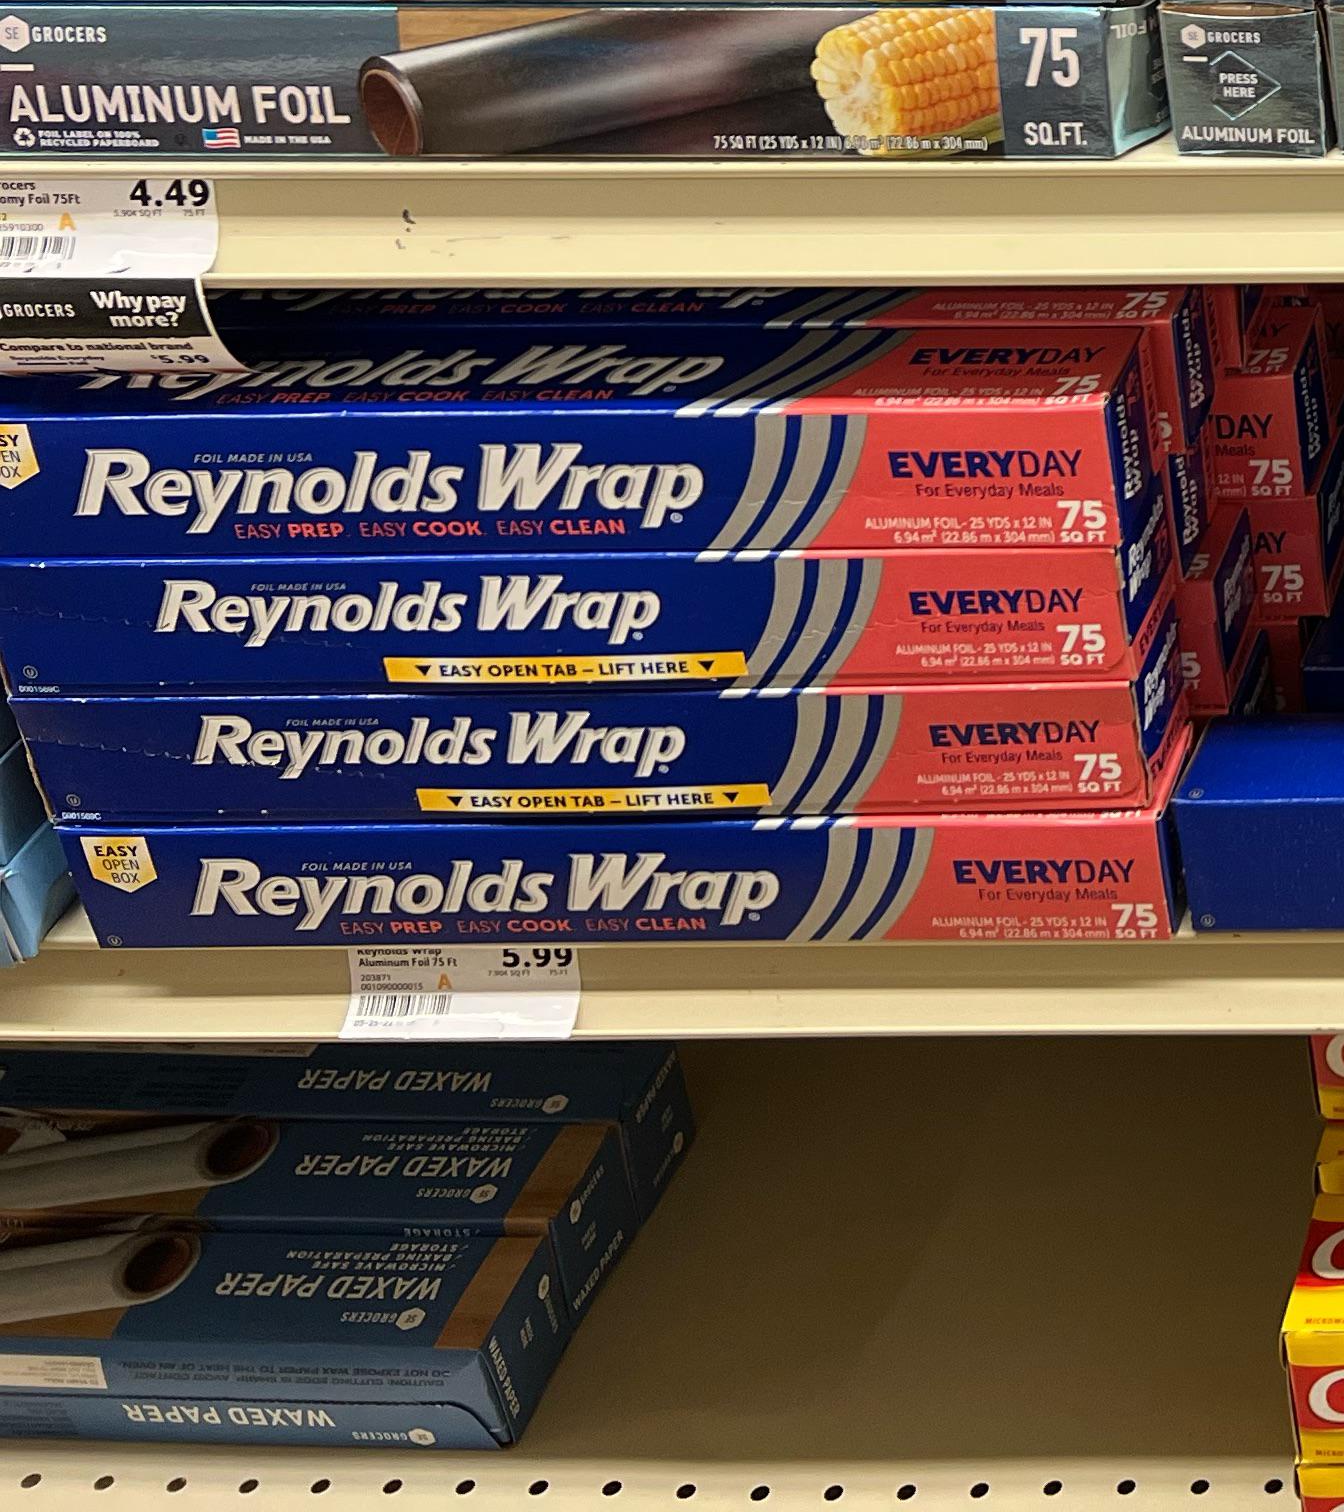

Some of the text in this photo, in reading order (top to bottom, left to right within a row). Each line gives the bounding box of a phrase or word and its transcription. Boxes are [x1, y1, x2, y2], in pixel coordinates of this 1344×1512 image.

[31, 26, 107, 44] GROCERS
[1019, 26, 1081, 88] 75
[9, 84, 351, 125] ALUMINUM FOIL
[1024, 121, 1088, 147] SQ.FT.
[129, 178, 210, 207] 4.49
[90, 290, 187, 314] Why pay
[109, 311, 179, 328] more?
[888, 449, 1082, 479] EVERYDAY
[74, 443, 705, 534] Reynolds Wrap
[1056, 500, 1107, 530] 75
[439, 663, 576, 678] EASY OPEN TAB
[93, 844, 138, 859] EASY
[101, 858, 141, 872] OPEN
[110, 871, 141, 885] BOX
[501, 948, 573, 968] 5.99
[122, 1403, 337, 1428] WAXED PAPER
